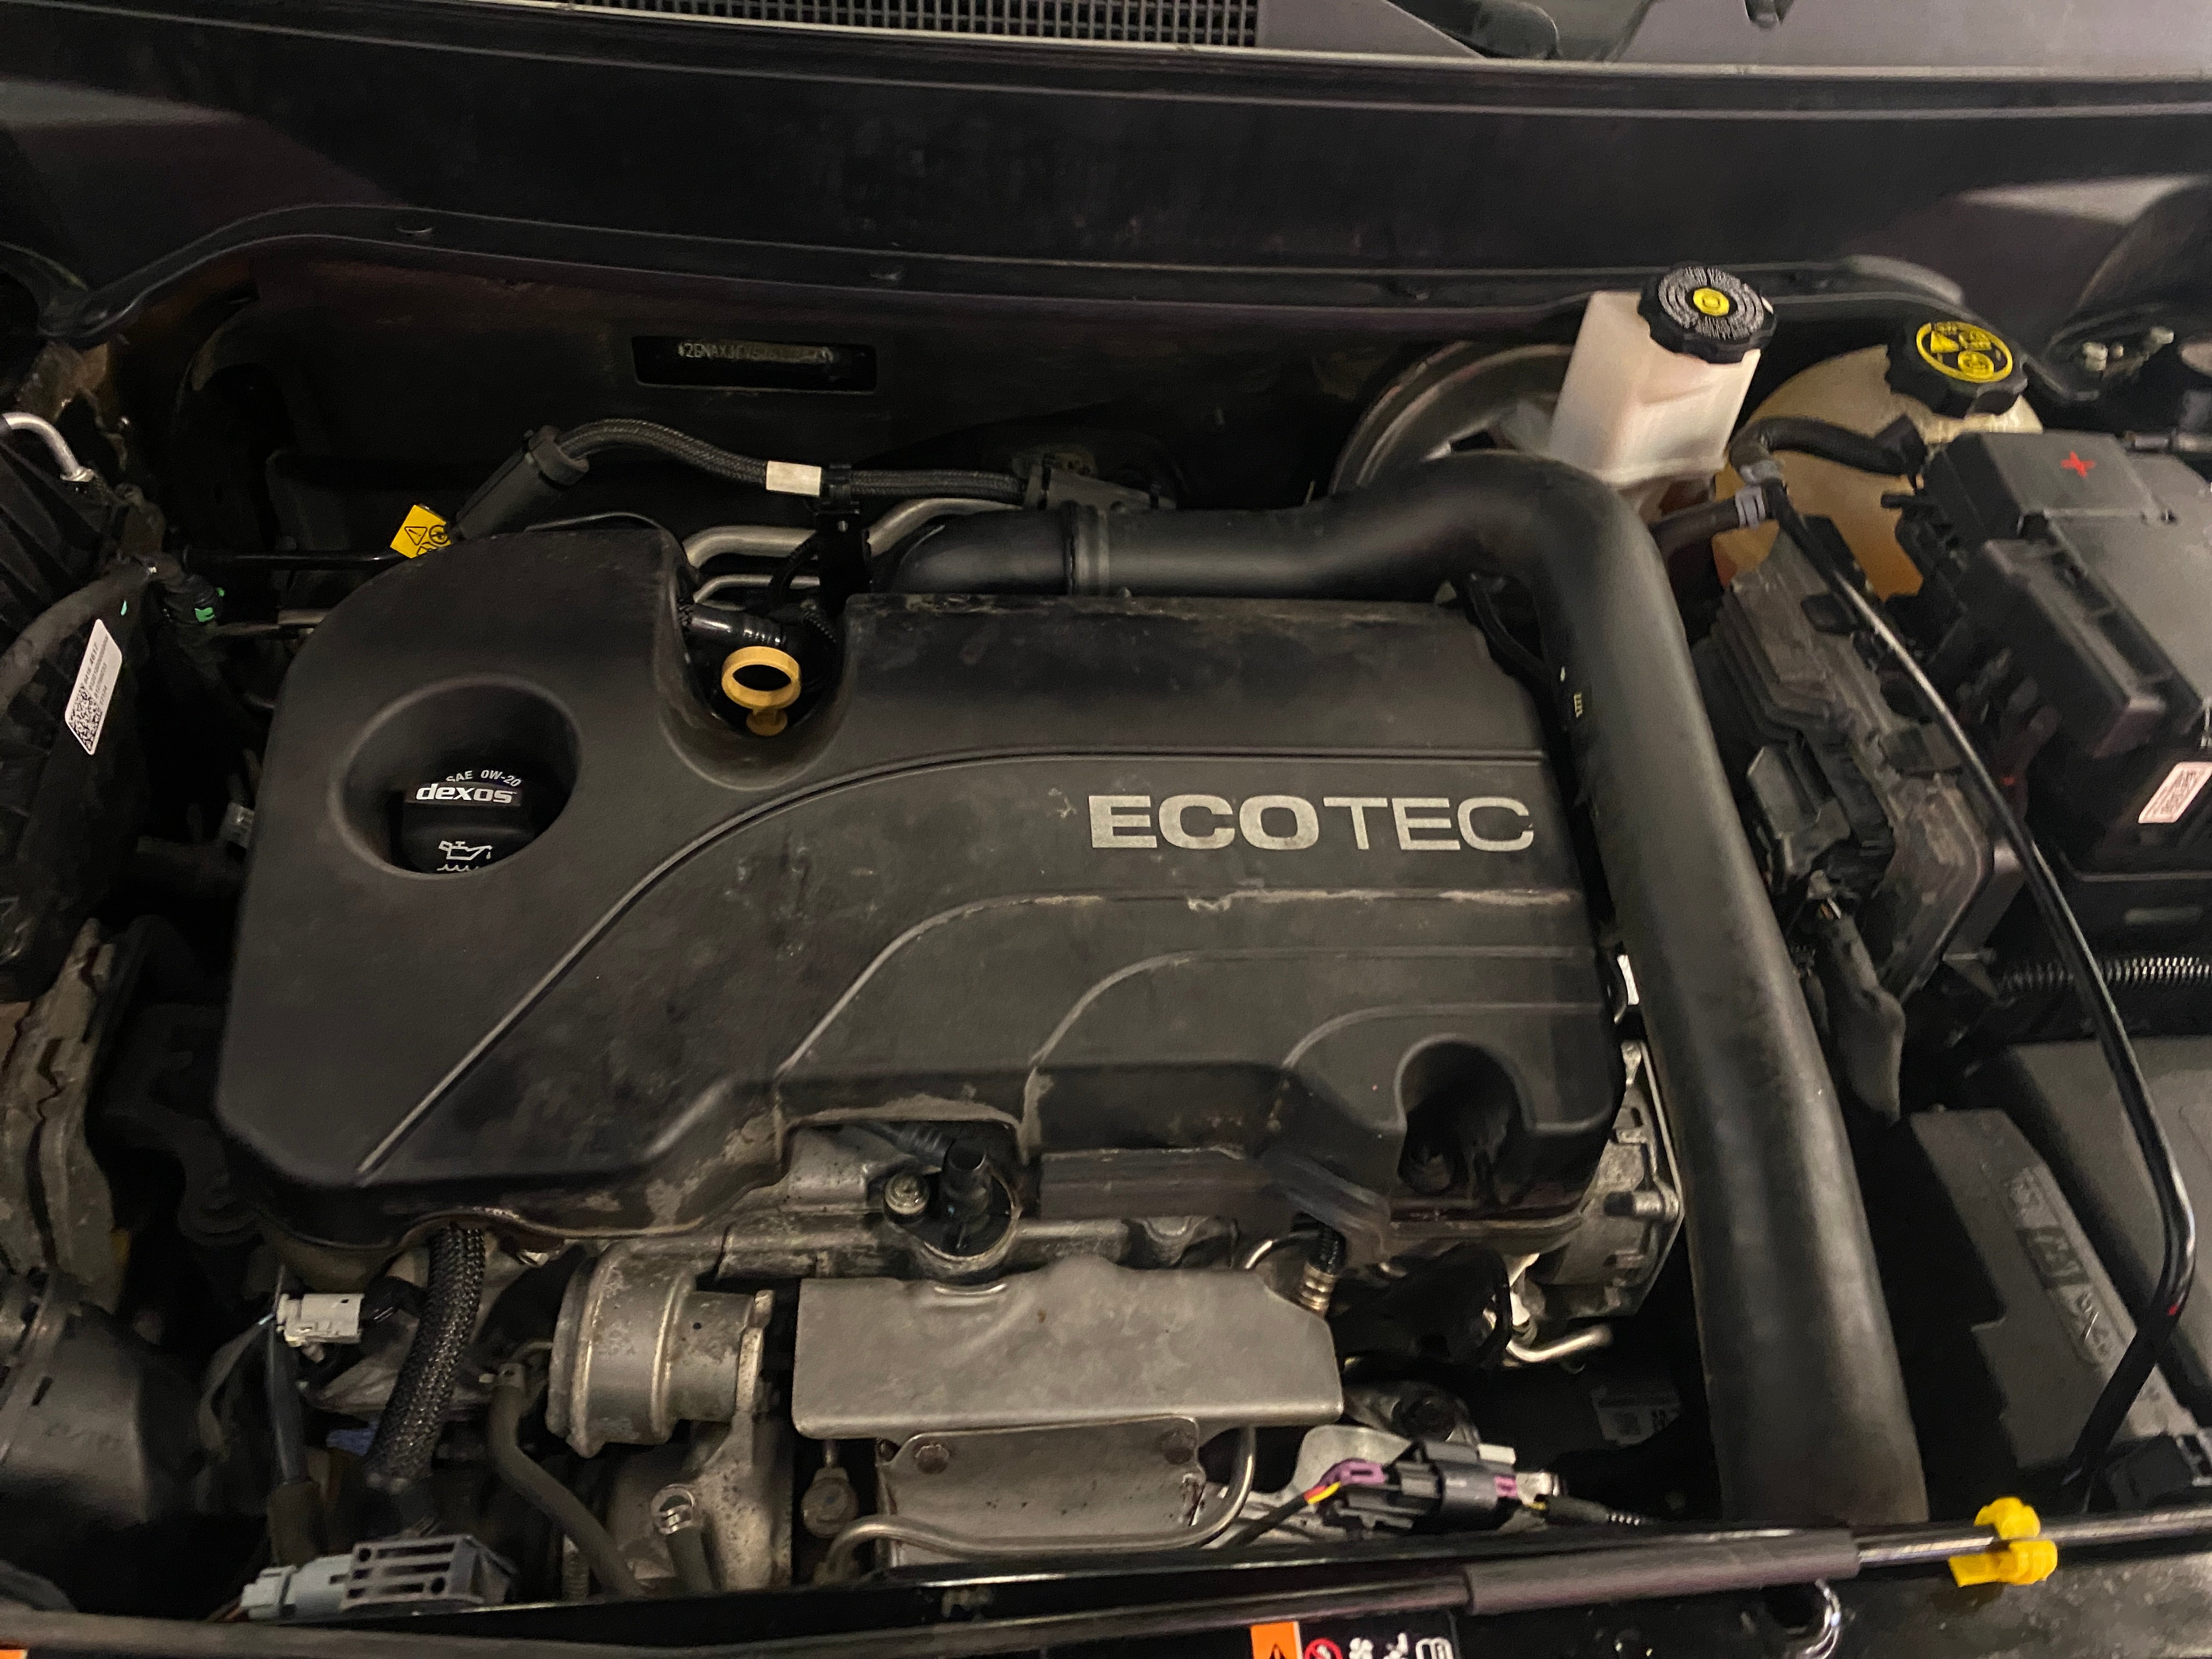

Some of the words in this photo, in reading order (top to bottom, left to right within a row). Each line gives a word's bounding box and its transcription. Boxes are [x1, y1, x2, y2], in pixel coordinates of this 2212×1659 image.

[445, 770, 473, 782] SAE
[480, 769, 522, 787] 0W-20
[415, 783, 516, 804] dexos
[1088, 794, 1534, 852] ECOTEC
